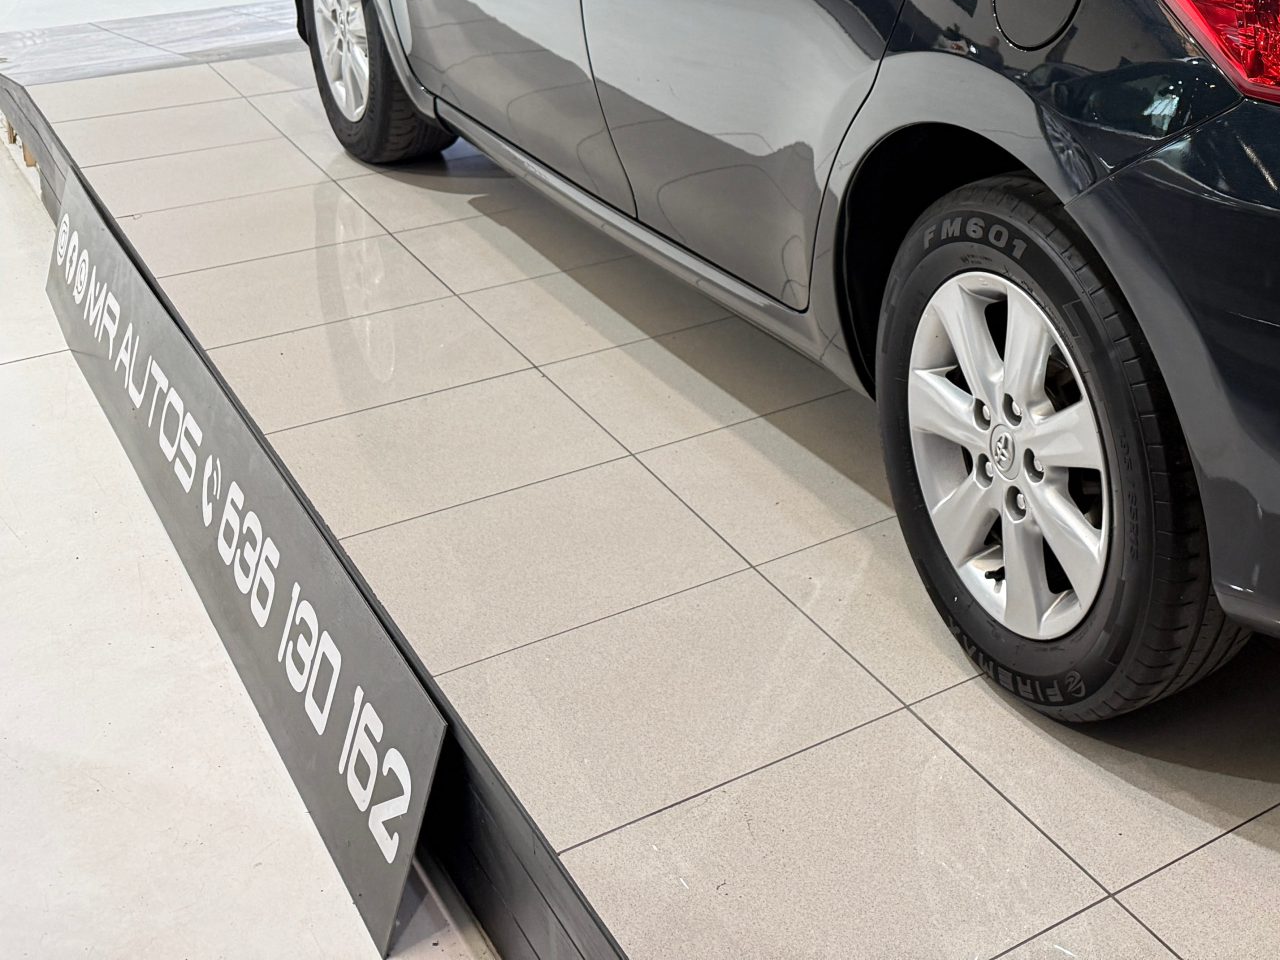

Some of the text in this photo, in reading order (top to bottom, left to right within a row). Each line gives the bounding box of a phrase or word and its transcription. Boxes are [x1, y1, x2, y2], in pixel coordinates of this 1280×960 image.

[923, 217, 1028, 260] FM601
[83, 265, 412, 864] MR AUTOS 636 130 162
